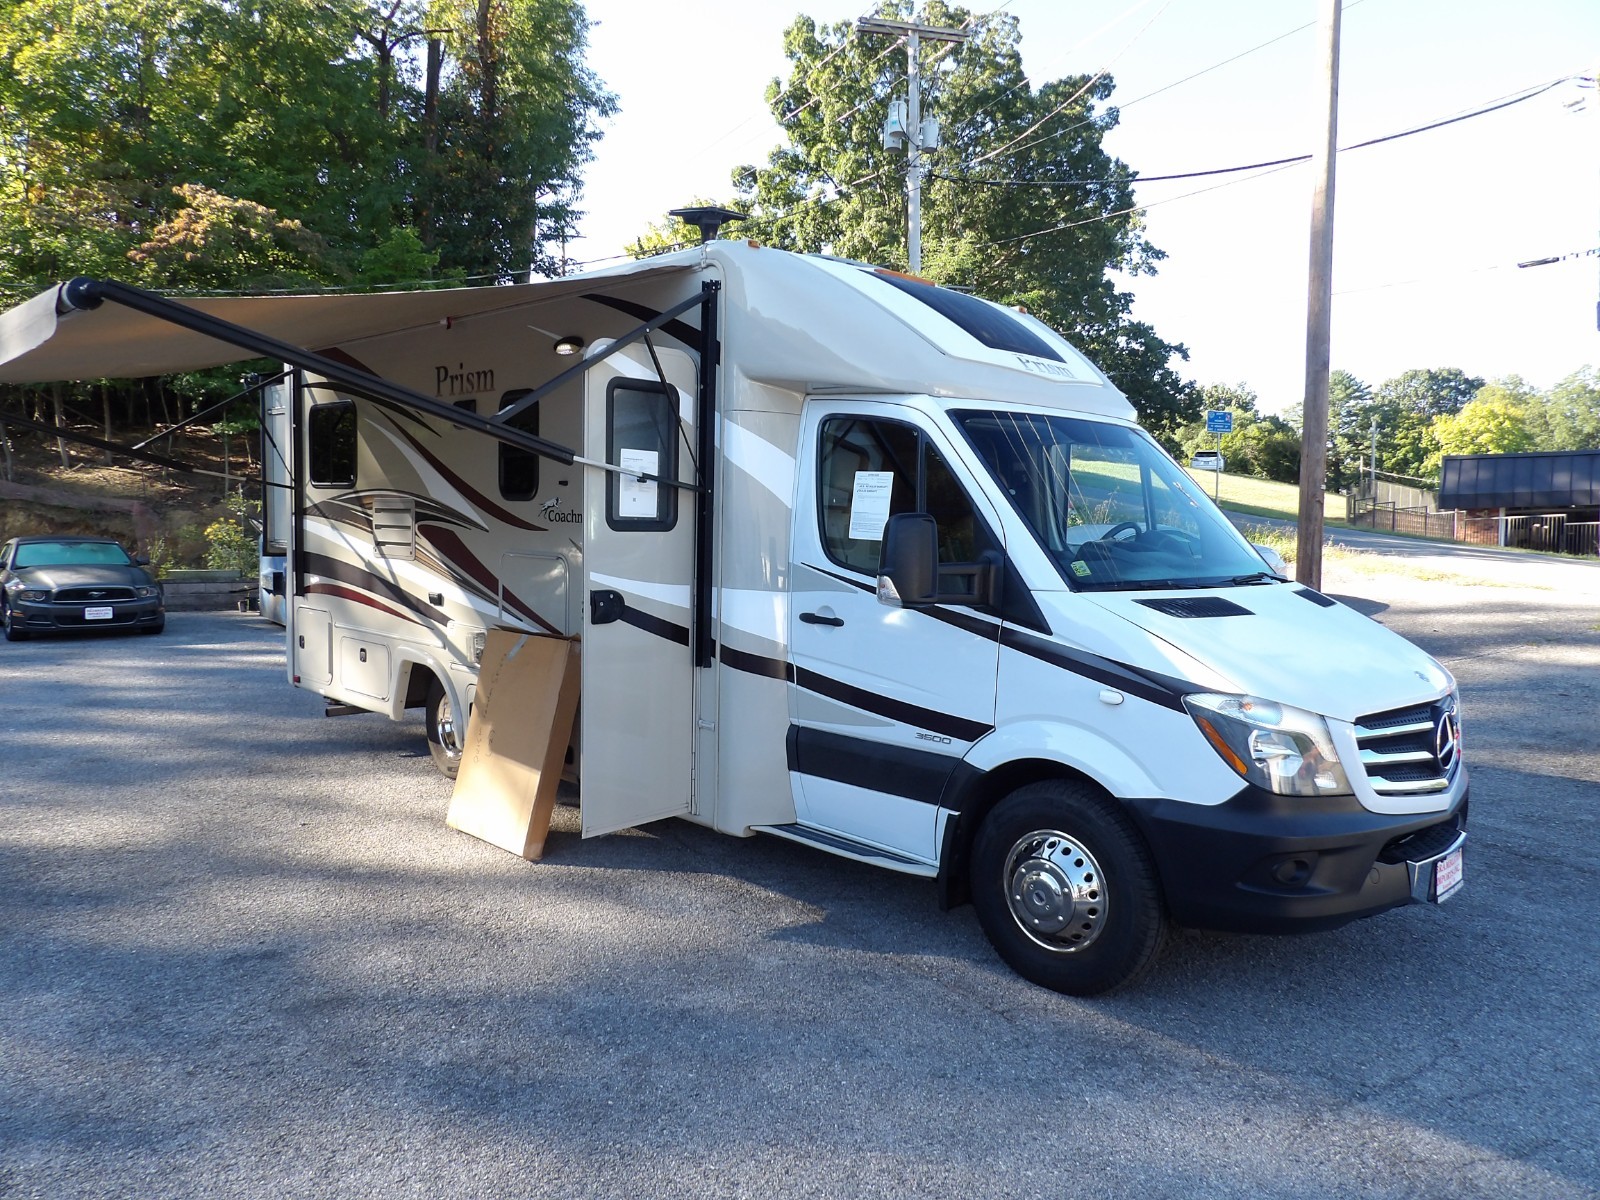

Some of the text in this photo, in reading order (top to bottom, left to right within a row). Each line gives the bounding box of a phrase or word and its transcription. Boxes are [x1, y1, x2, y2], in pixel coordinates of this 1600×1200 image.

[1012, 353, 1078, 379] Prism
[435, 362, 496, 397] Prism
[915, 732, 952, 745] 3500
